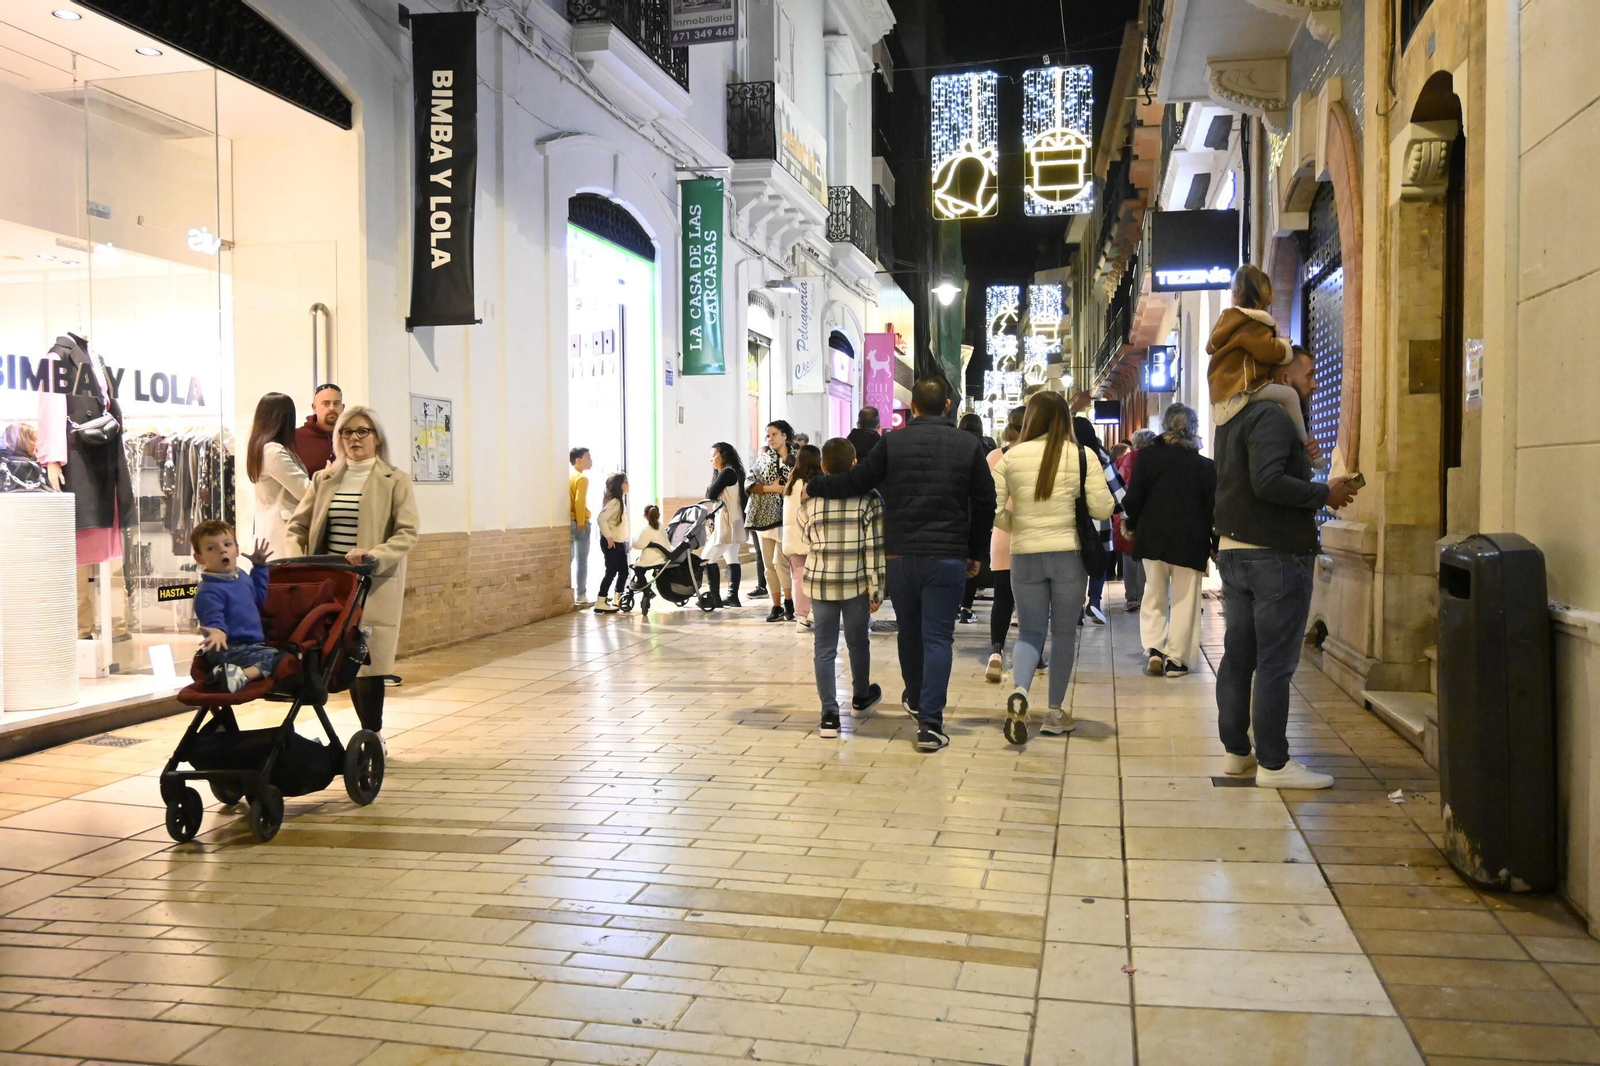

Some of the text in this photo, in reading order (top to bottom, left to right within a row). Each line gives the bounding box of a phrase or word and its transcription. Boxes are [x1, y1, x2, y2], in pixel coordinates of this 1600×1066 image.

[672, 27, 734, 41] 671 349 468
[673, 14, 732, 26] Inmobiliaria
[430, 70, 453, 269] BIMBA Y LOLA
[689, 204, 702, 351] LA CASA DE LAS
[704, 230, 717, 324] CARCASAS
[0, 354, 206, 406] IMBA Y LOLA
[160, 587, 185, 599] HASTA
